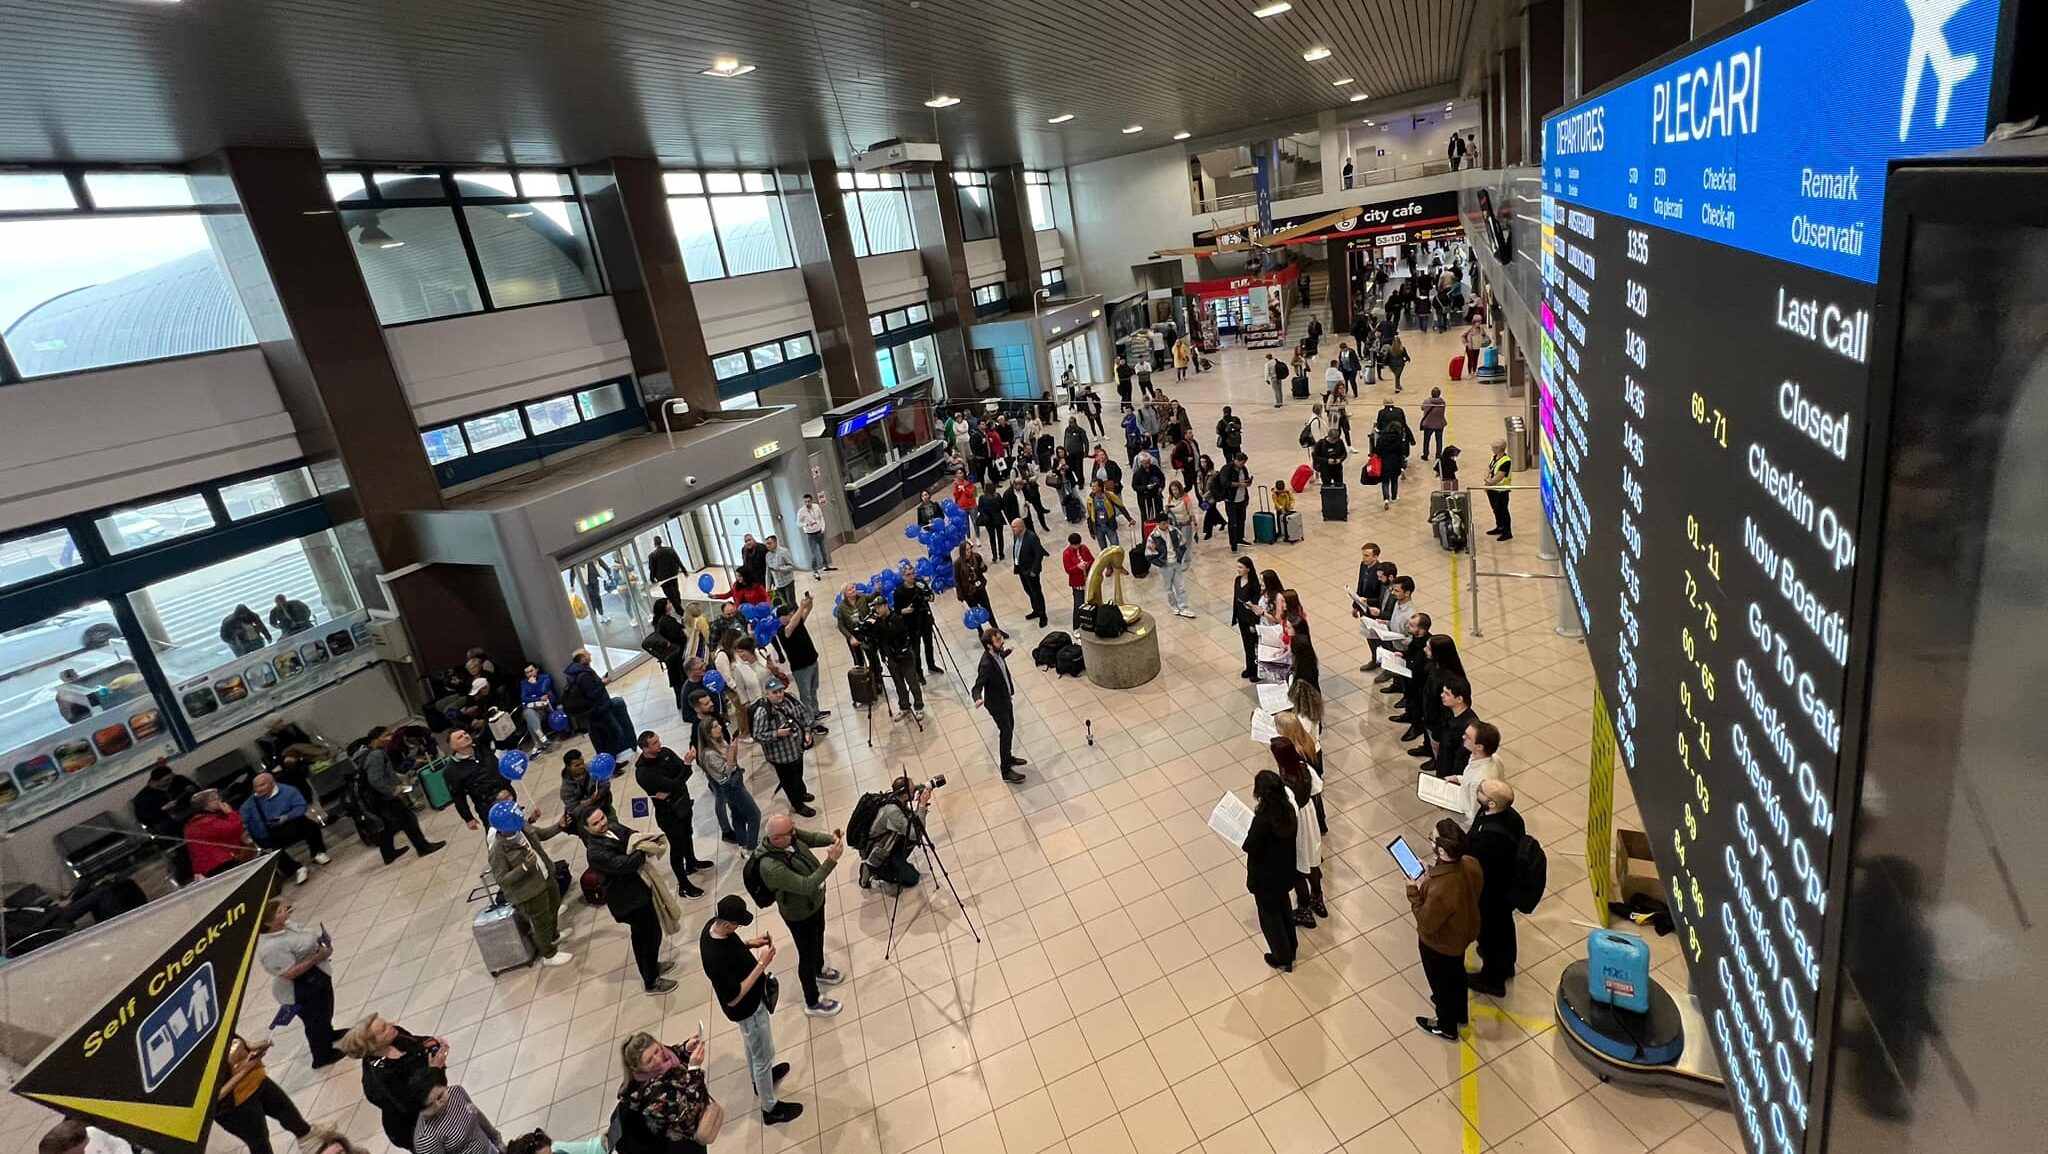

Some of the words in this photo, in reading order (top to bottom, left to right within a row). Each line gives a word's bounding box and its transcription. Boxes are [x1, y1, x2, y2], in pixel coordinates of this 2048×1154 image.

[1652, 45, 1761, 145] PLECARI
[1556, 105, 1605, 156] DEPARTURES
[1654, 167, 1666, 186] ETD
[1703, 166, 1737, 193] Check-in
[1801, 165, 1860, 201] Remark
[1364, 208, 1389, 223] city
[1392, 202, 1423, 218] cafe
[1701, 202, 1735, 230] Check-in
[1791, 214, 1864, 256] Observatii
[1627, 229, 1649, 265] 13:55
[1626, 279, 1648, 318] 14:20
[1777, 286, 1818, 341] Last
[1822, 303, 1869, 363] Call
[1625, 328, 1646, 369] 14:30
[1624, 375, 1645, 419] 14:35
[1691, 392, 1704, 424] 69
[1713, 409, 1727, 448] 71
[1779, 380, 1849, 461] Closed
[1623, 420, 1644, 467] 14:35
[1622, 465, 1643, 514] 14:45
[1749, 443, 1814, 532] Checkin
[1819, 506, 1856, 571] Op
[1621, 509, 1641, 559] 15:00
[1687, 514, 1699, 550] 01
[1708, 543, 1720, 580] 11
[1744, 515, 1779, 580] Now
[1620, 550, 1639, 604] 15:15
[1685, 569, 1696, 608] 72
[1705, 601, 1717, 641] 75
[1682, 627, 1694, 661] 60
[1702, 663, 1715, 701] 65
[1749, 602, 1772, 652] Go
[1775, 633, 1795, 686] To
[1678, 732, 1689, 770] 01
[1681, 681, 1691, 719] 01
[1700, 721, 1711, 760] 11
[1737, 658, 1795, 774] Checkin
[1799, 762, 1834, 836] Op
[1733, 723, 1790, 847] Checkin
[1793, 838, 1828, 915] Op
[1737, 802, 1757, 857] Go
[1760, 844, 1777, 900] To
[1726, 845, 1778, 981] Checkin
[83, 997, 137, 1058] Self
[148, 902, 246, 998] Check-In
[1722, 902, 1774, 1043] Checkin
[1719, 956, 1769, 1102] Checkin
[1716, 1009, 1764, 1154] Checkin
